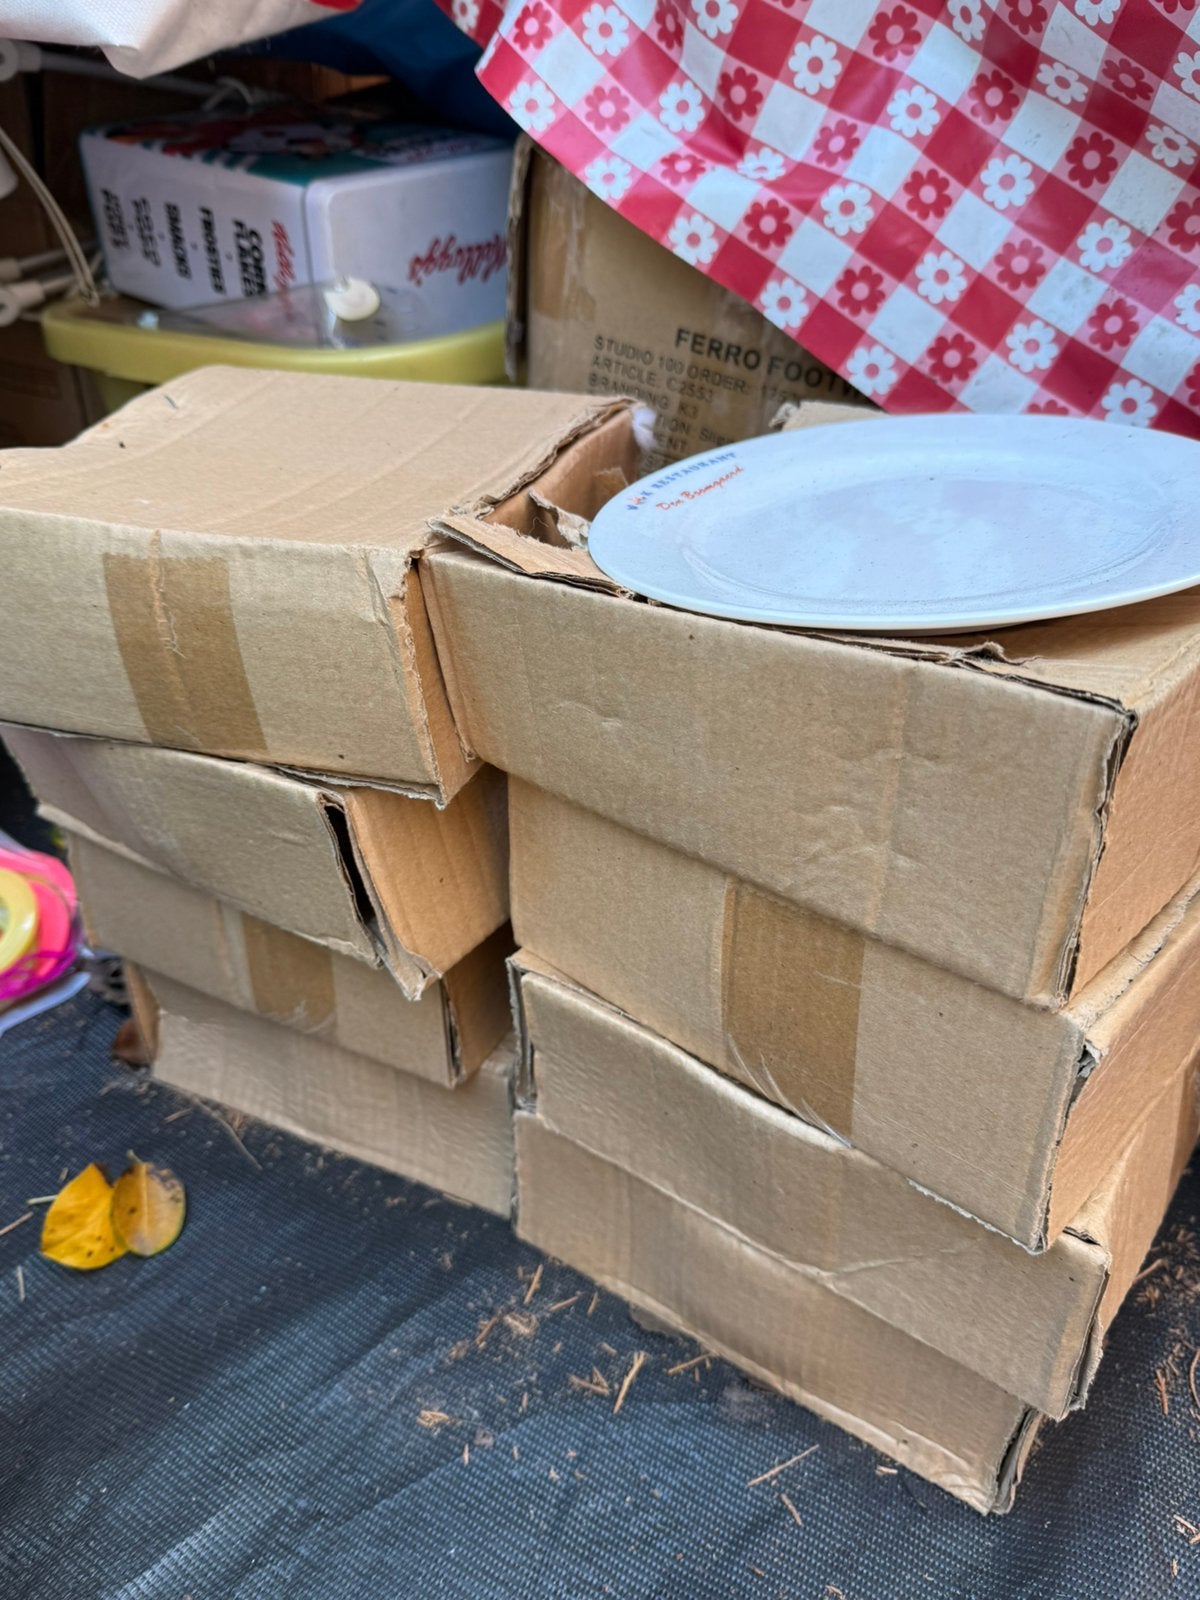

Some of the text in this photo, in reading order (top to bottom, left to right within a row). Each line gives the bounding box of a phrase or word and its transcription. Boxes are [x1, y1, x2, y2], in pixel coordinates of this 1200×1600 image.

[165, 203, 191, 279] SMACKS
[200, 206, 226, 294] FROSTIES
[233, 218, 257, 297] FLAKES
[249, 228, 266, 296] CORN
[594, 335, 655, 366] STUDIO
[658, 354, 686, 375] 100
[674, 327, 761, 371] FERRO
[651, 451, 737, 490] RESTAURANT
